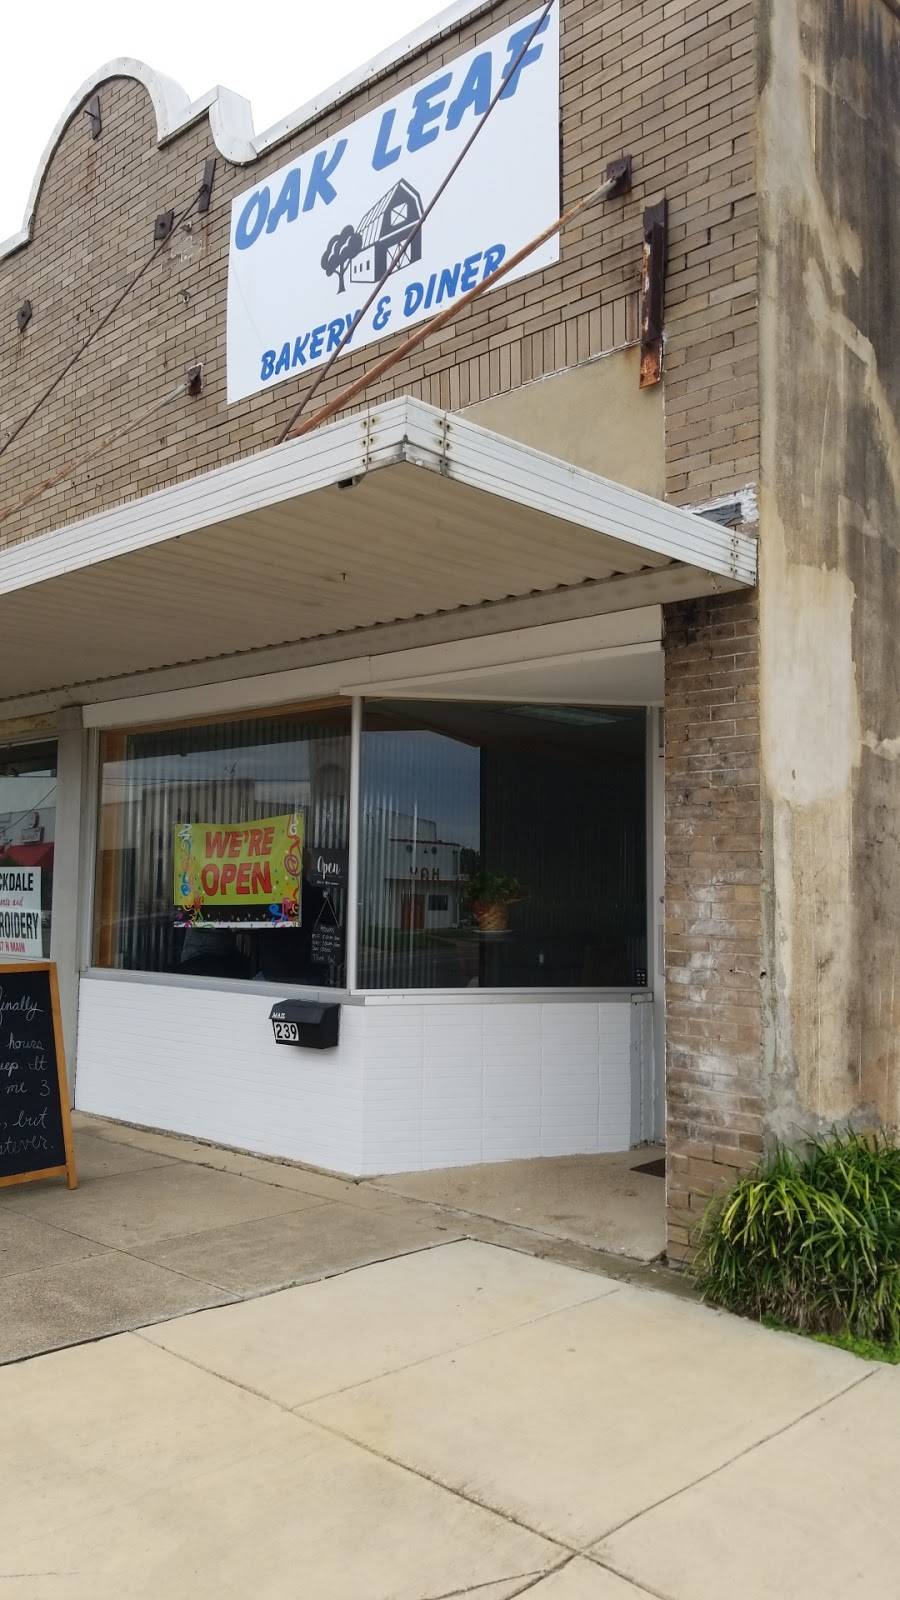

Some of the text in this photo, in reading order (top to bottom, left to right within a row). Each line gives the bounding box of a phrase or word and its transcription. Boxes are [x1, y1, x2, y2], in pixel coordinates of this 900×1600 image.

[234, 14, 551, 251] OAK LEAF
[260, 243, 507, 382] BAKERY & DINER
[205, 827, 275, 858] WE'RE
[201, 862, 273, 897] OPEN
[317, 855, 341, 880] Open
[276, 1023, 297, 1039] 239
